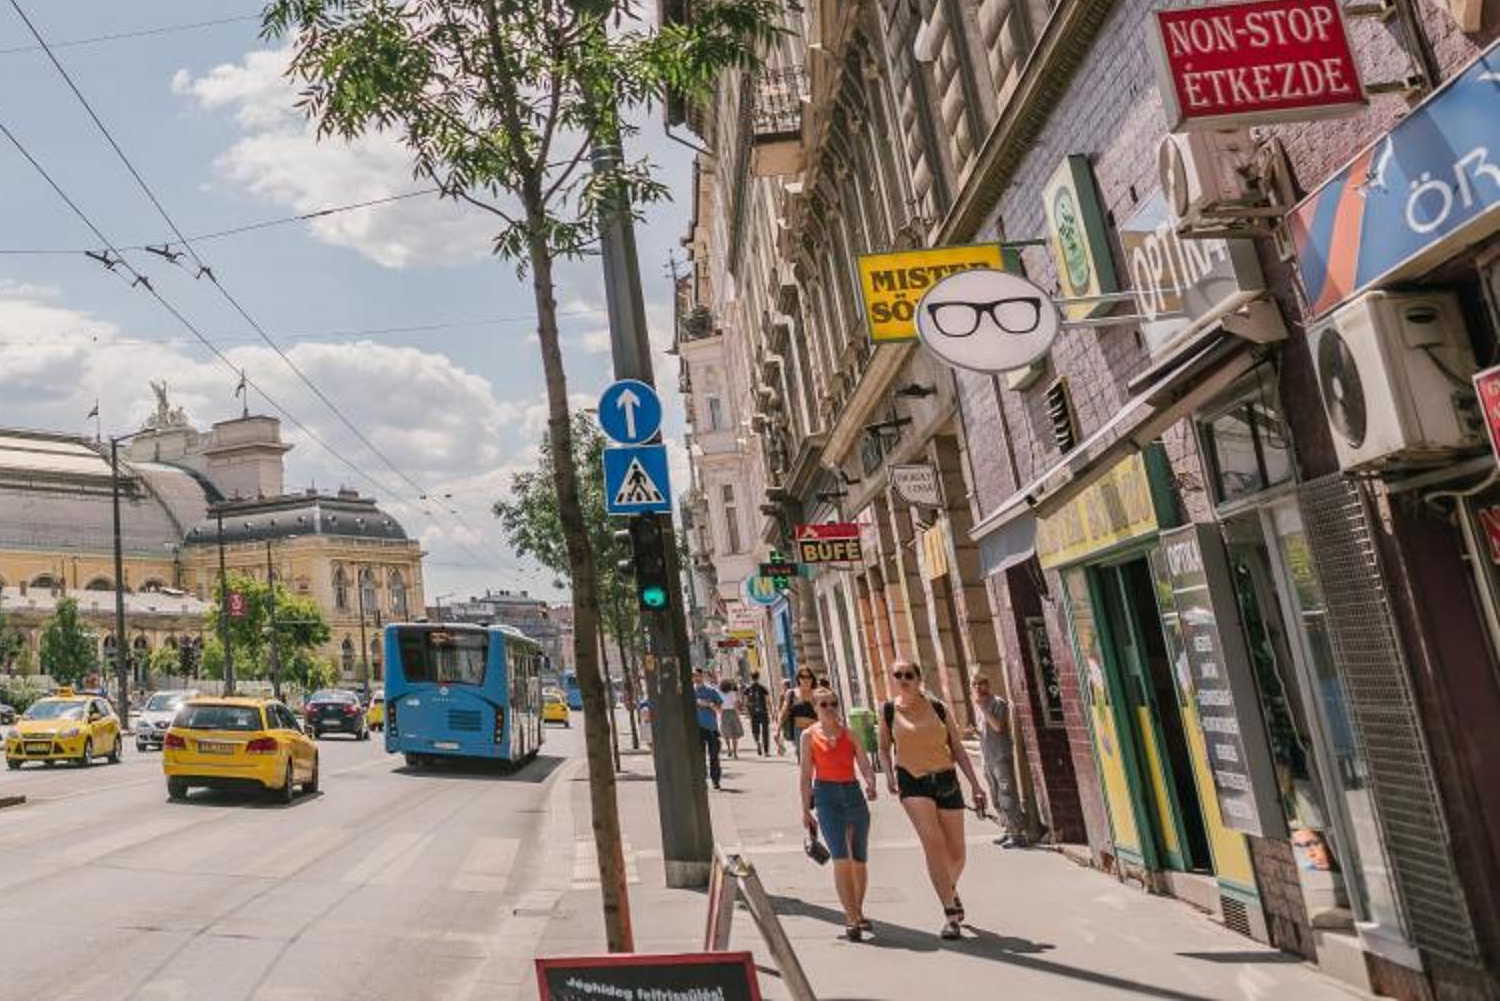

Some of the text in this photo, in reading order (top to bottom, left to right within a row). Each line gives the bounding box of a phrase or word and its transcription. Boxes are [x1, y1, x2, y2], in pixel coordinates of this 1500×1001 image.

[1167, 5, 1334, 56] NON-STOP
[1183, 57, 1350, 108] ÉTKEZDE
[869, 262, 990, 293] MIST
